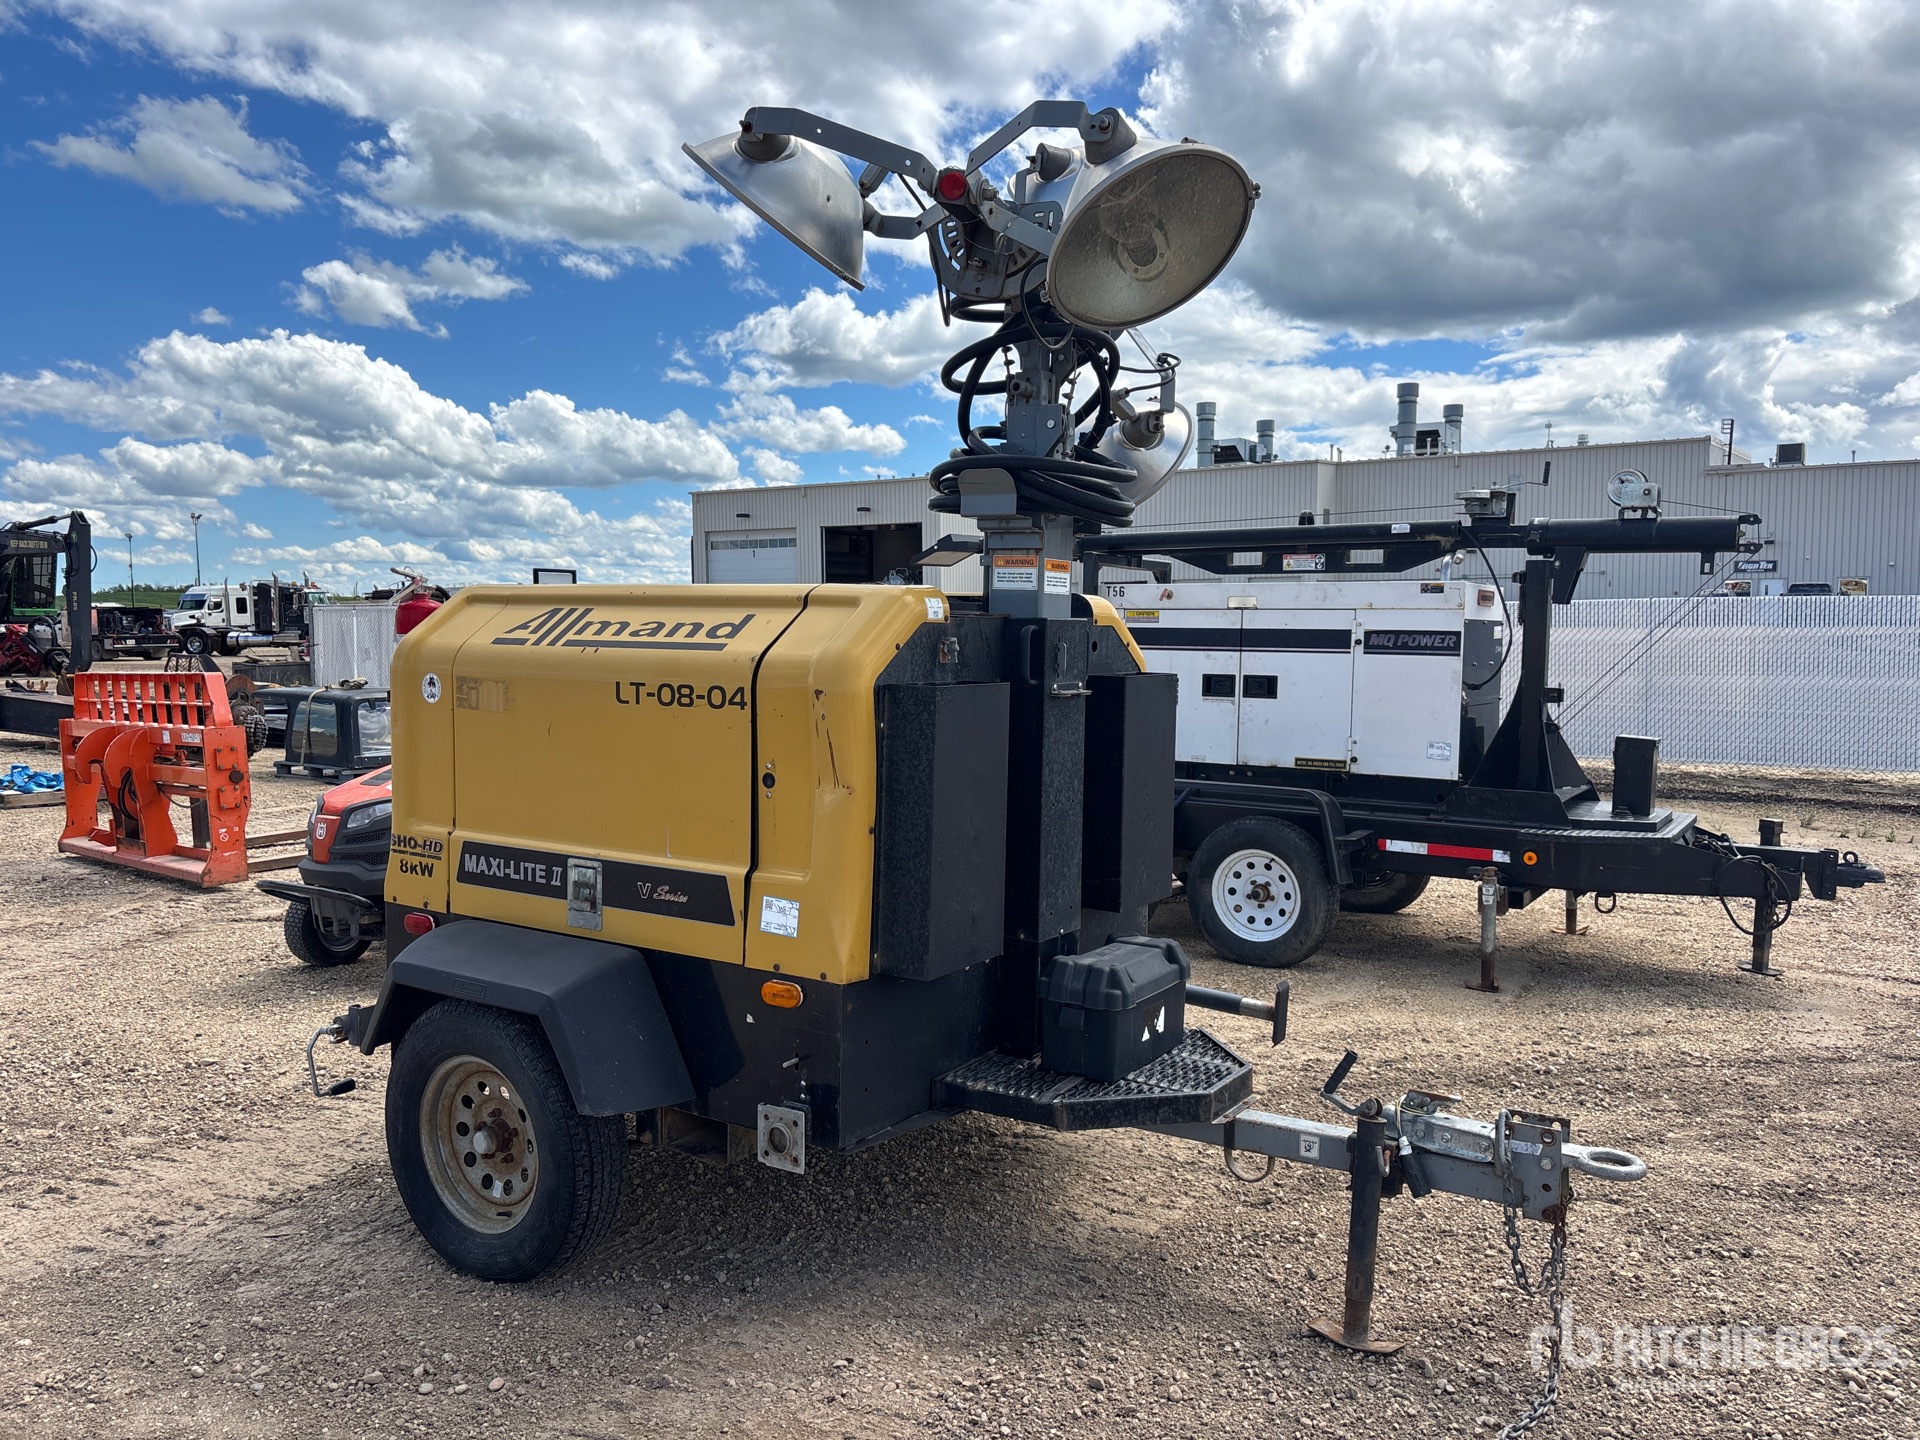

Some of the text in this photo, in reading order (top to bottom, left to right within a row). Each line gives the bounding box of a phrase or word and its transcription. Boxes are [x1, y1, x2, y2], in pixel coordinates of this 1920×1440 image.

[752, 549, 756, 559] 1
[1051, 563, 1068, 571] WARNING
[1106, 586, 1125, 597] T56
[503, 608, 757, 646] Allmand
[1368, 634, 1457, 647] MQ POWER
[615, 681, 749, 711] LT-08-04
[400, 858, 434, 878] 8kW
[464, 853, 547, 883] MAXI-LITE
[637, 882, 689, 904] V Series
